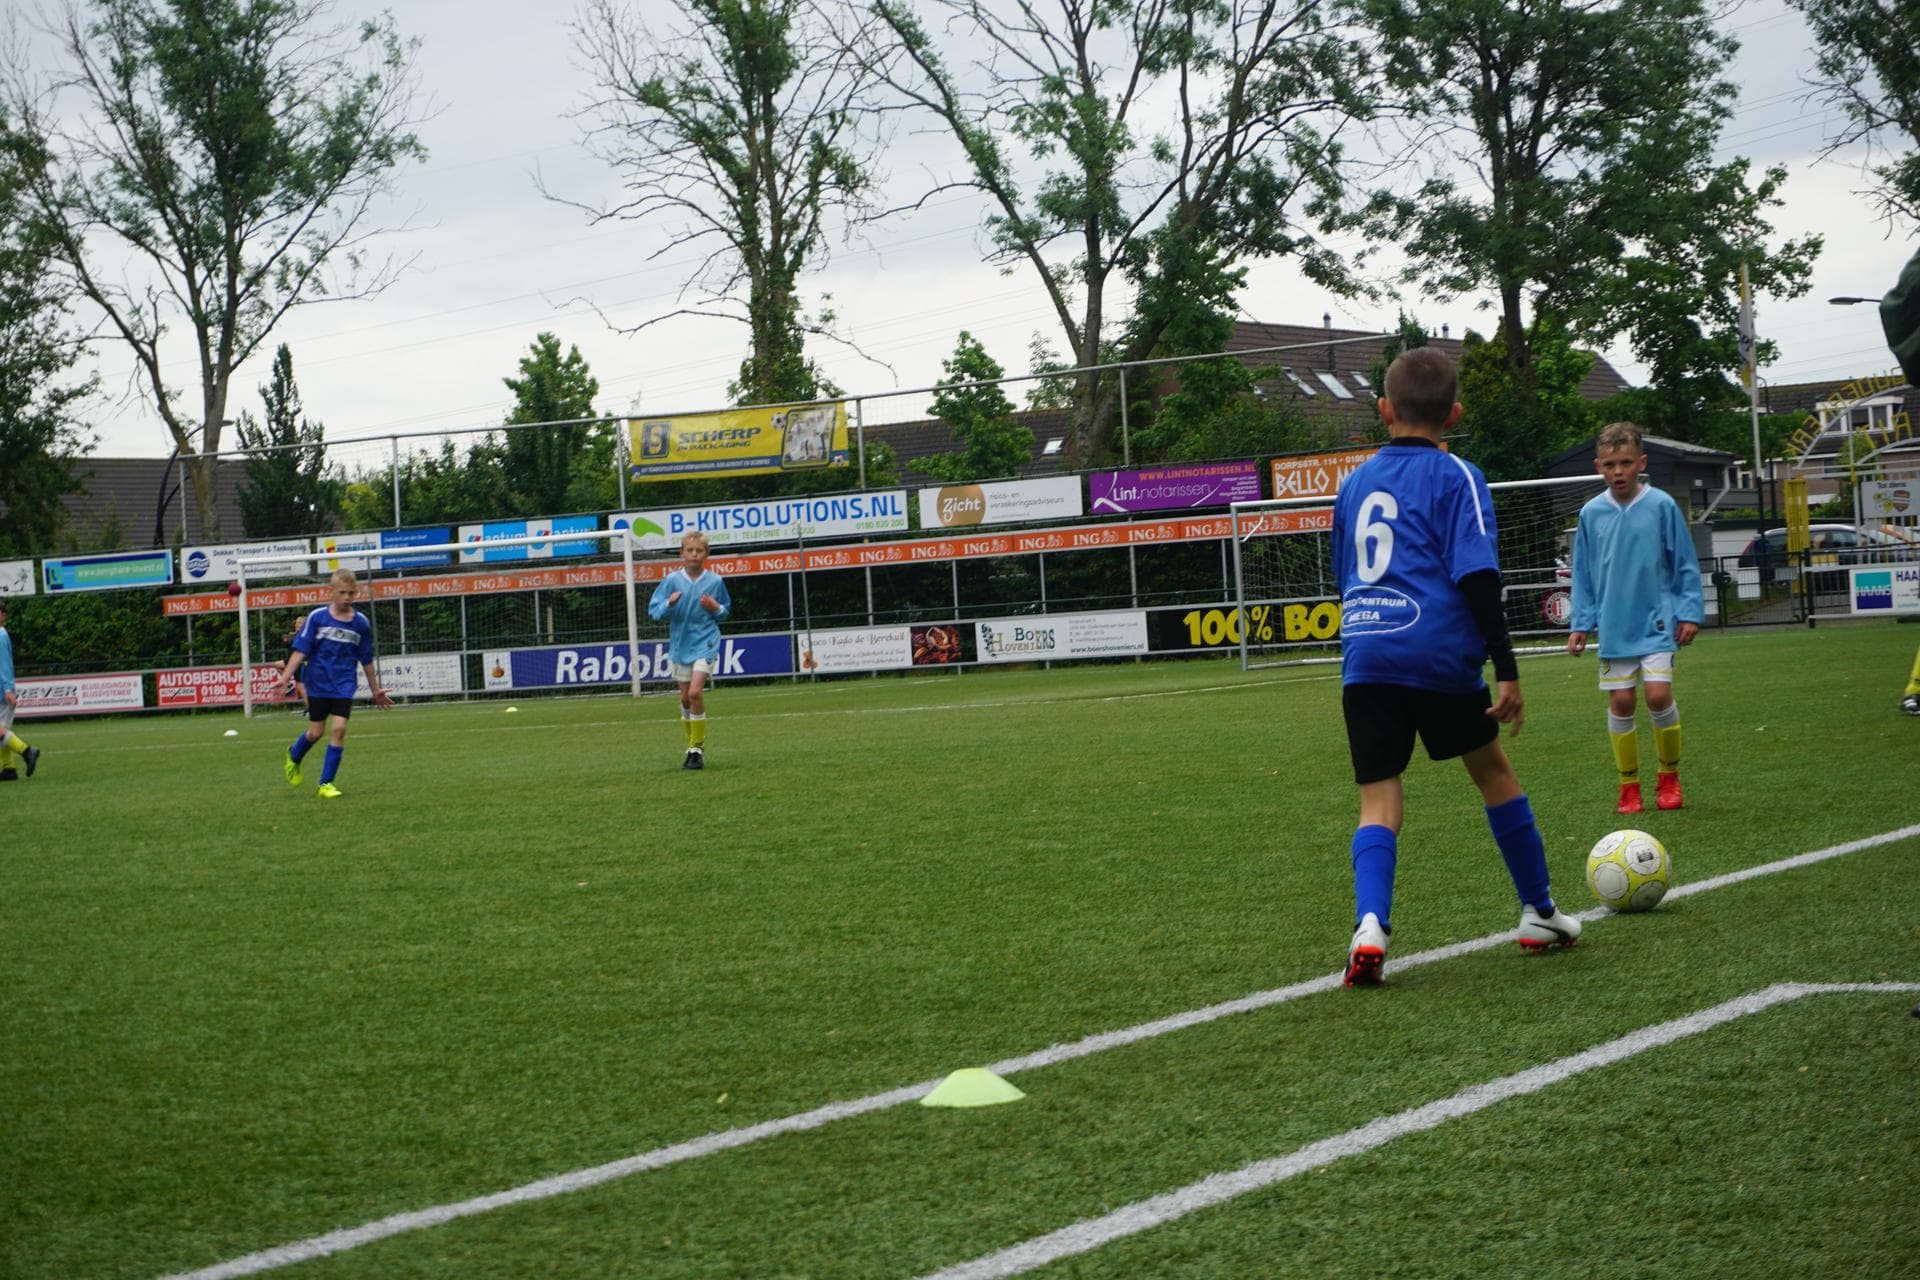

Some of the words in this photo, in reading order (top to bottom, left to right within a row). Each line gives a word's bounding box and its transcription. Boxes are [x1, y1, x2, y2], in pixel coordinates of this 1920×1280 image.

[678, 427, 761, 444] SCHERP
[1139, 463, 1257, 481] WWW.LINTNOTARISSEN.NL
[1275, 467, 1330, 497] BELLO
[670, 494, 902, 534] B-KITSOLUTIONS.NL
[942, 496, 981, 522] Zicht
[1355, 491, 1398, 583] 6
[168, 600, 189, 612] ING
[210, 598, 231, 610] ING
[252, 595, 273, 607] ING
[296, 591, 317, 602] ING
[383, 585, 405, 596] ING
[428, 582, 450, 593] ING
[473, 579, 496, 590] ING
[565, 573, 589, 585] ING
[710, 562, 734, 574] ING
[759, 559, 783, 571] ING
[808, 554, 833, 567] ING
[860, 550, 885, 562] ING
[911, 546, 937, 558] ING
[963, 542, 989, 555] ING
[1019, 537, 1045, 550] ING
[1073, 532, 1100, 546] ING
[1128, 528, 1155, 541] ING
[1184, 524, 1212, 537] ING
[1299, 516, 1326, 529] ING
[1343, 597, 1408, 608] UTOCENTRUM
[1183, 605, 1273, 646] 100%
[1283, 601, 1342, 641] BO
[555, 639, 746, 684] Rabobk
[201, 684, 227, 695] 0180
